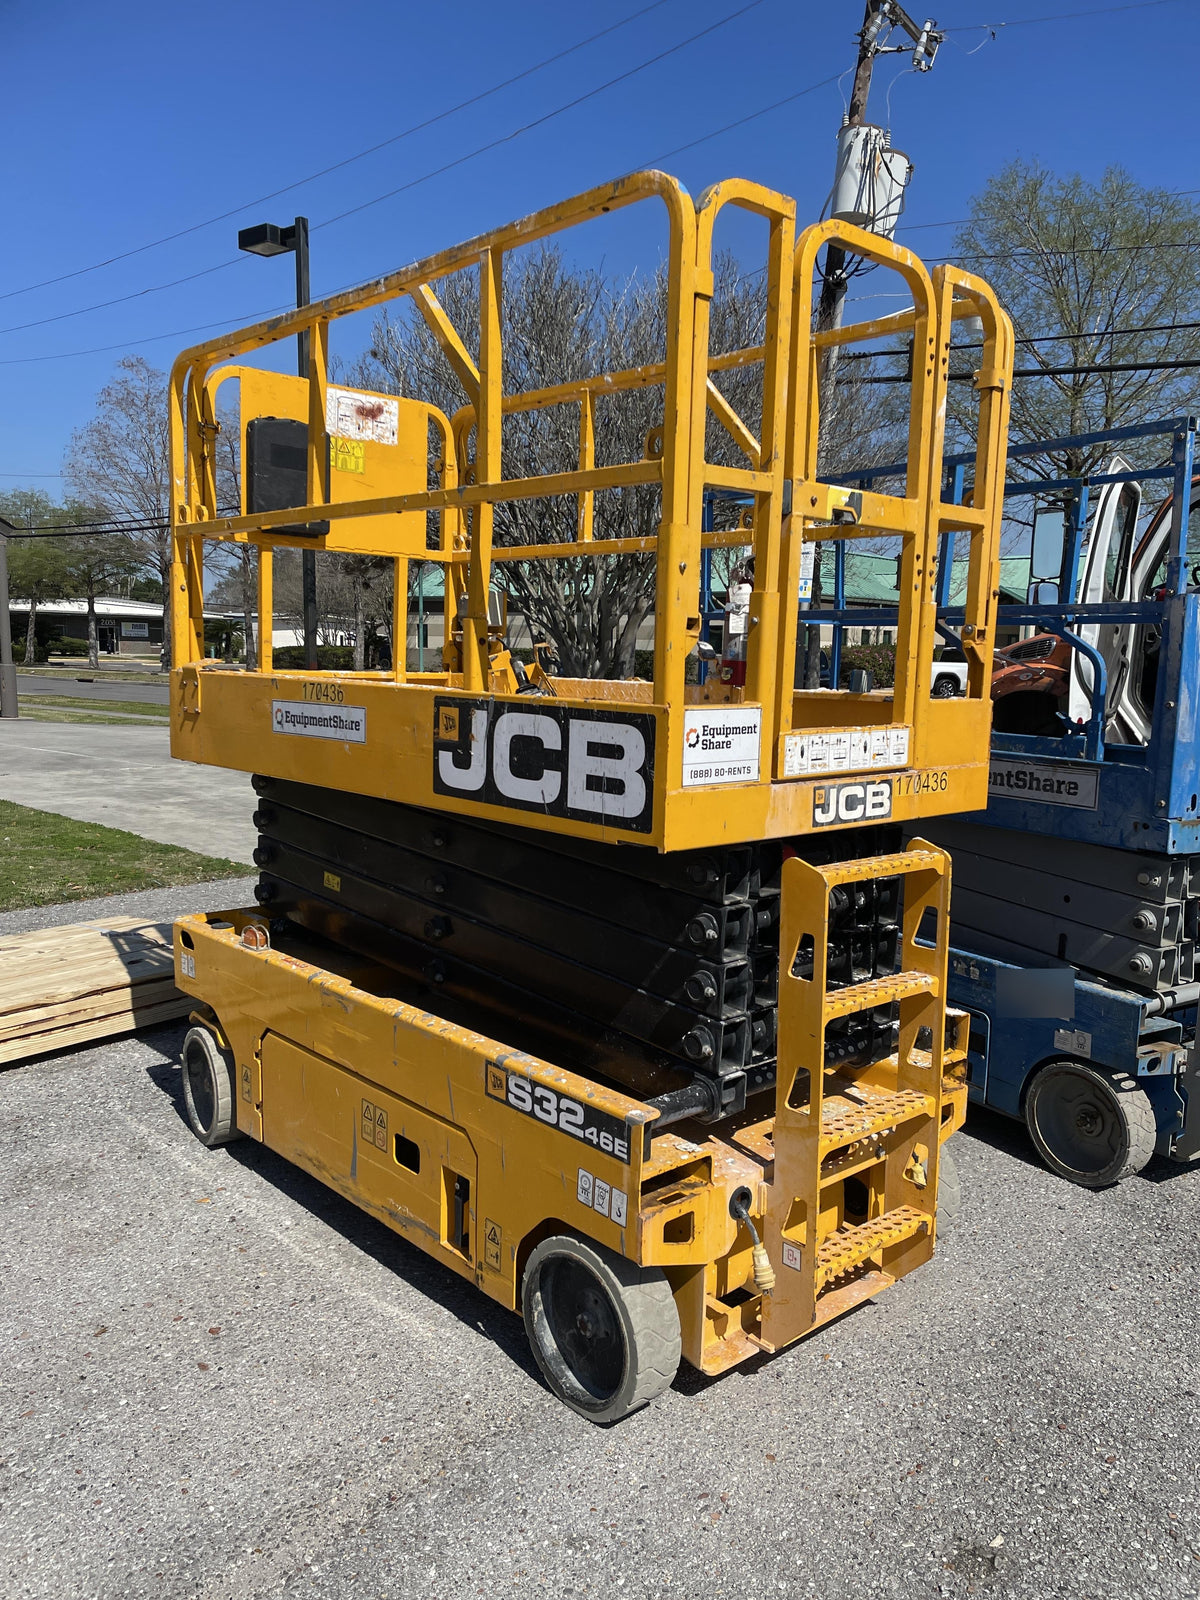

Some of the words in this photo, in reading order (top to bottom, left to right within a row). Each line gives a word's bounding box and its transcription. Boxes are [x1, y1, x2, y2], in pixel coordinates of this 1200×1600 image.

[302, 682, 344, 702] 170436
[284, 710, 361, 732] EquipmentShare
[702, 724, 758, 738] Equipment
[701, 739, 732, 750] Share
[438, 709, 646, 818] JCB
[690, 768, 713, 780] (888)
[714, 765, 752, 777] 80-RENTS
[896, 771, 948, 796] 170436
[814, 783, 891, 824] JCB
